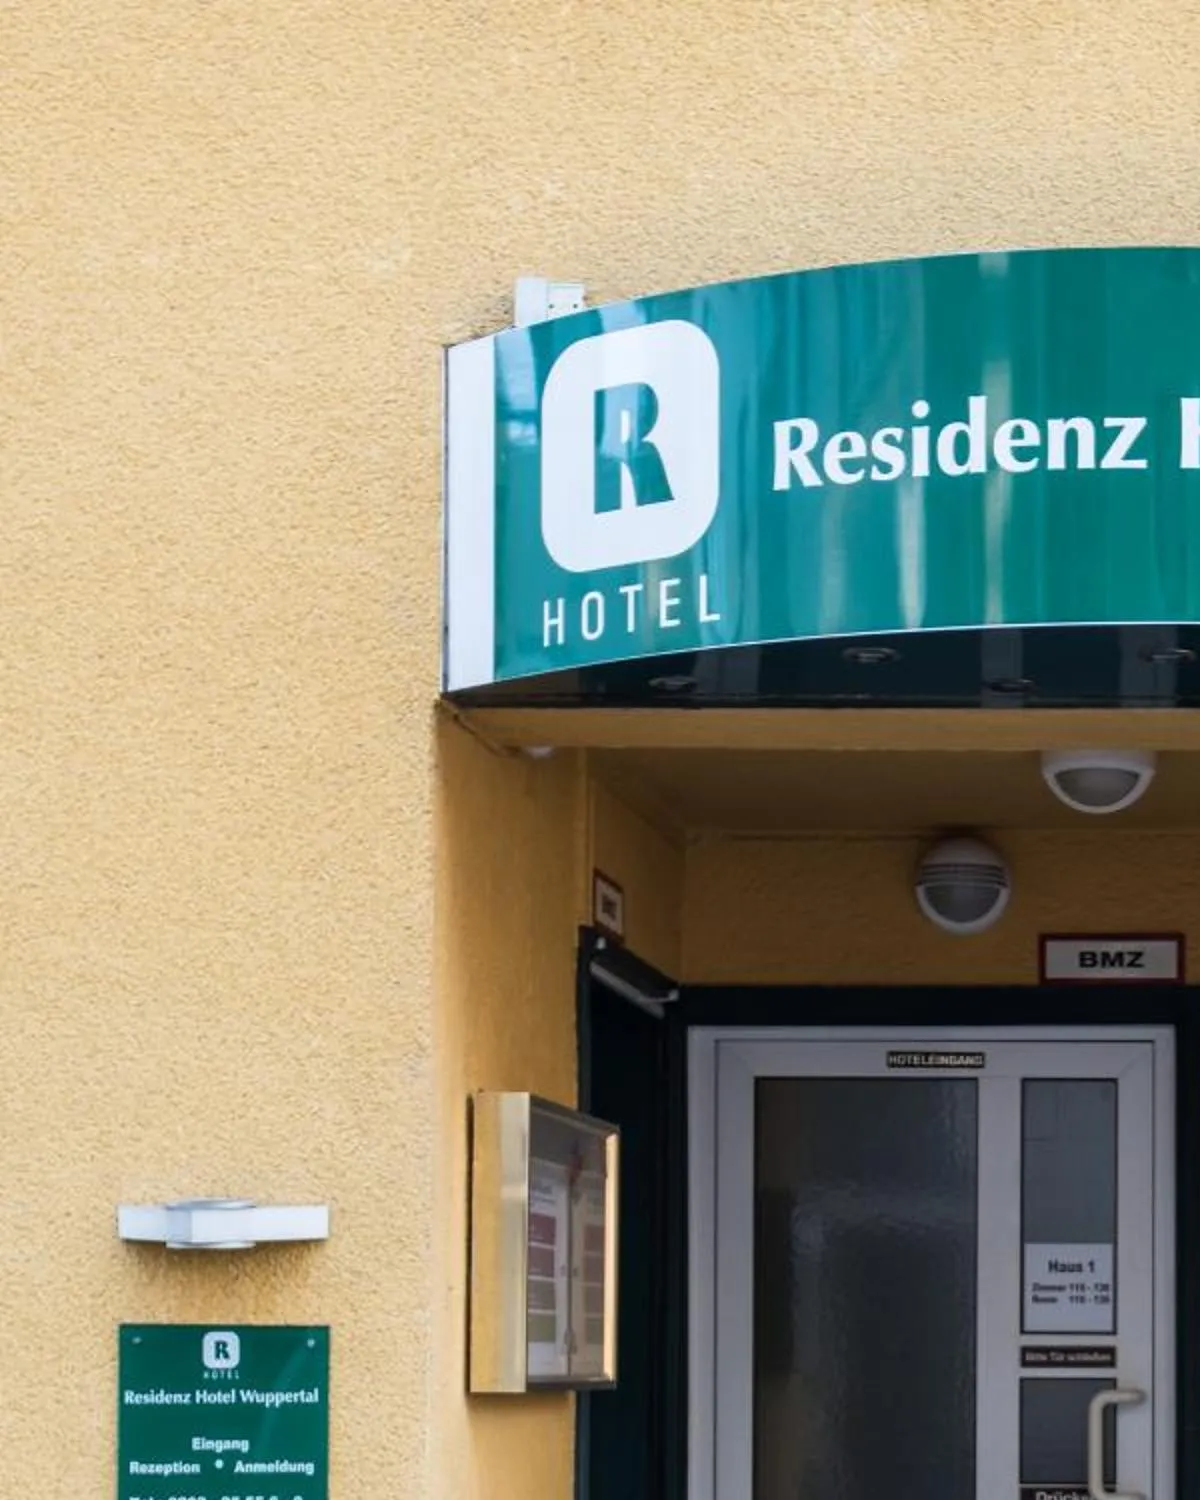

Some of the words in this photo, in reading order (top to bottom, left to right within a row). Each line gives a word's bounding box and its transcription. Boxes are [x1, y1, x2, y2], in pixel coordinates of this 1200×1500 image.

[593, 381, 675, 515] R
[772, 395, 1148, 492] Residenz
[543, 574, 722, 649] HOTEL
[1078, 951, 1145, 968] BMZ
[1048, 1260, 1083, 1273] Haus
[1088, 1260, 1095, 1273] 1
[214, 1340, 230, 1360] R
[203, 1370, 239, 1379] HOTEL
[124, 1389, 191, 1405] Residenz
[195, 1389, 235, 1404] Hotel
[240, 1388, 319, 1408] Wuppertal
[191, 1437, 250, 1453] Eingang
[129, 1461, 200, 1476] Rezeption
[233, 1460, 315, 1476] Anmeldung
